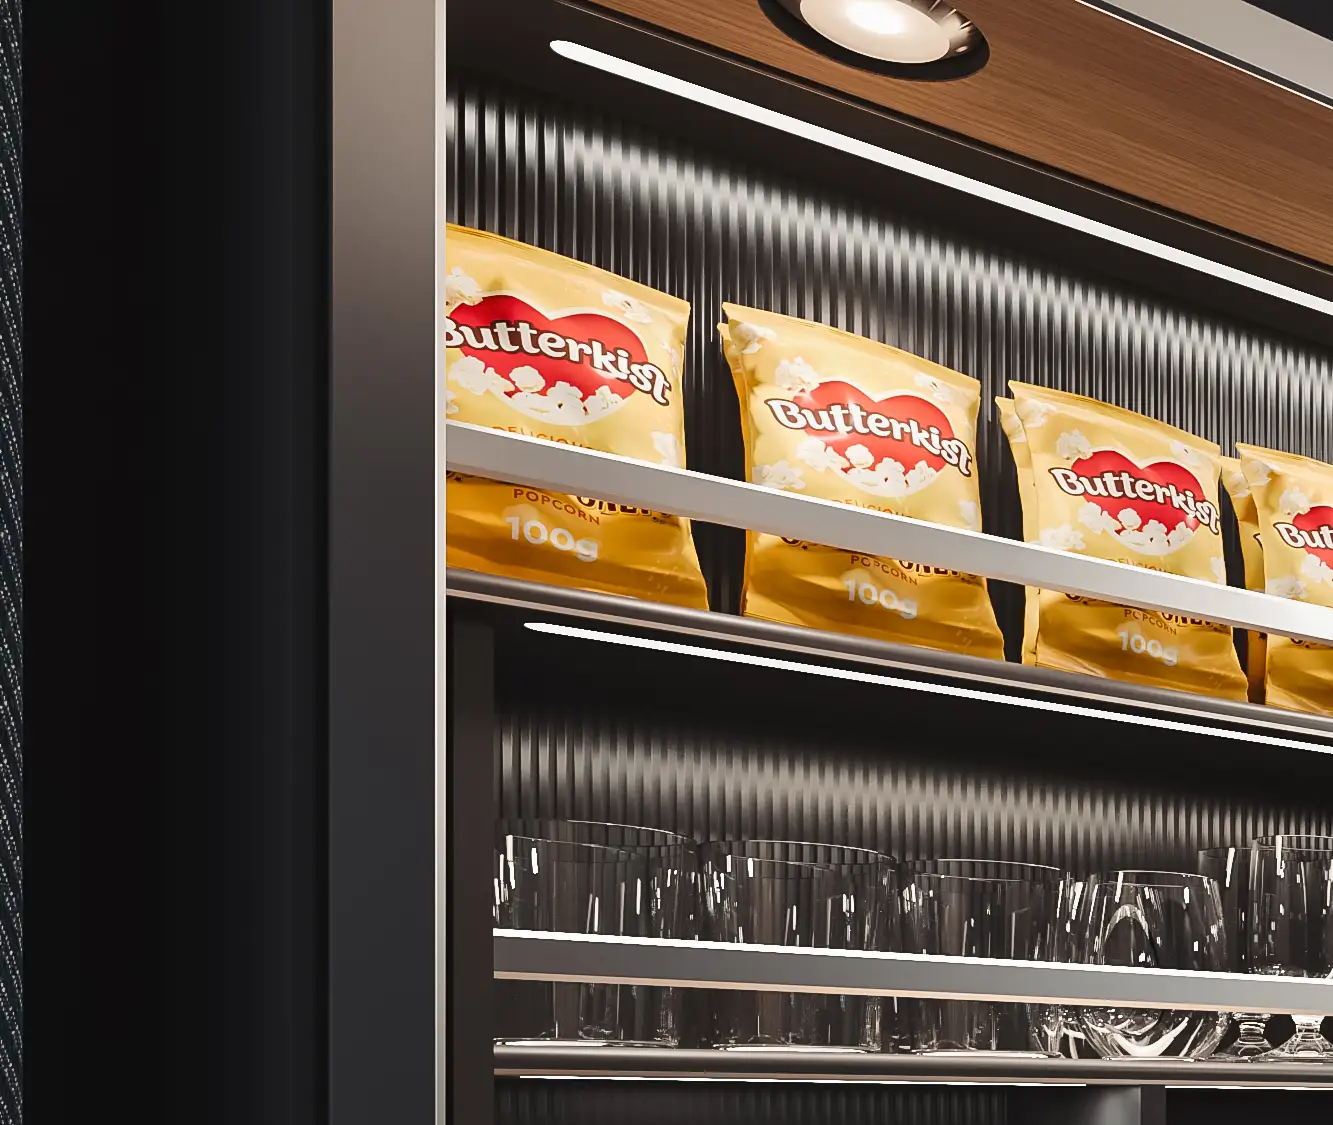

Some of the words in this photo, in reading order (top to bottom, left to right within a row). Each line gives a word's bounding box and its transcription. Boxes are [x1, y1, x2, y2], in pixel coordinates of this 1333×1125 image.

[446, 317, 673, 407] Butterkist
[766, 398, 973, 478] Butterkist
[513, 488, 600, 526] POPCORN
[1048, 467, 1221, 535] Butterkist
[505, 516, 599, 562] 100g
[850, 554, 918, 586] POPCORN
[843, 579, 919, 620] 100g
[1124, 608, 1178, 636] POPCORN
[1118, 631, 1179, 667] 100g
